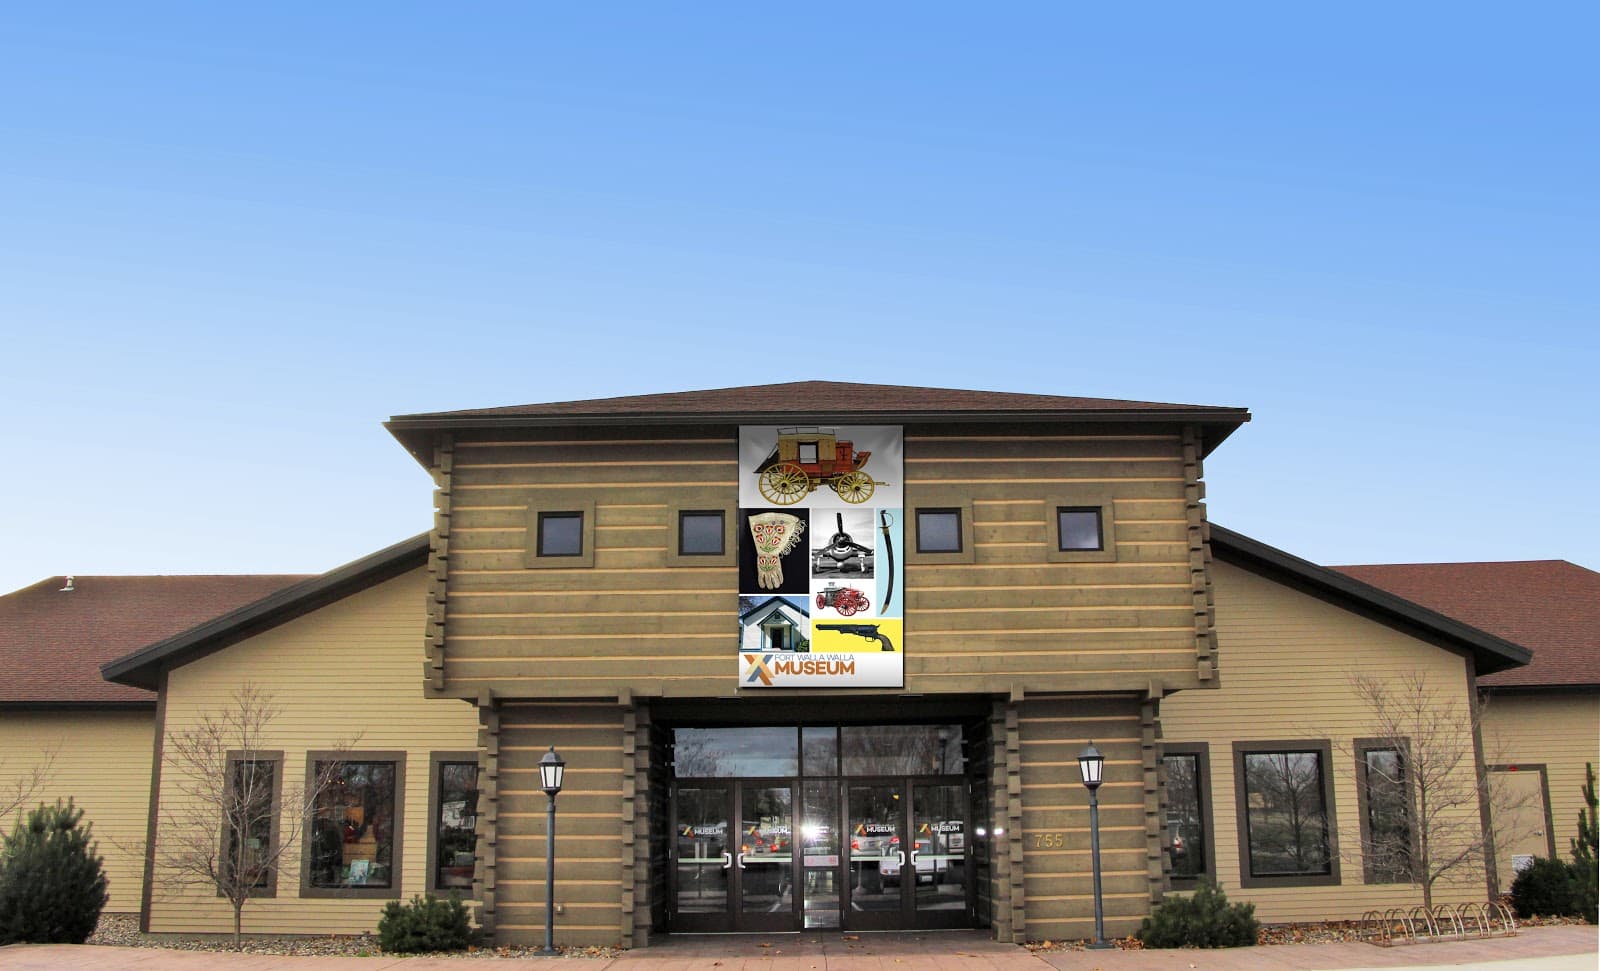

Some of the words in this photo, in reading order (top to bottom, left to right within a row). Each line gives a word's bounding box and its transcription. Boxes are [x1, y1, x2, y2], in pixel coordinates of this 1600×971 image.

[775, 661, 855, 675] MUSEUM
[931, 824, 960, 832] MUSEUM
[1035, 833, 1063, 849] 755
